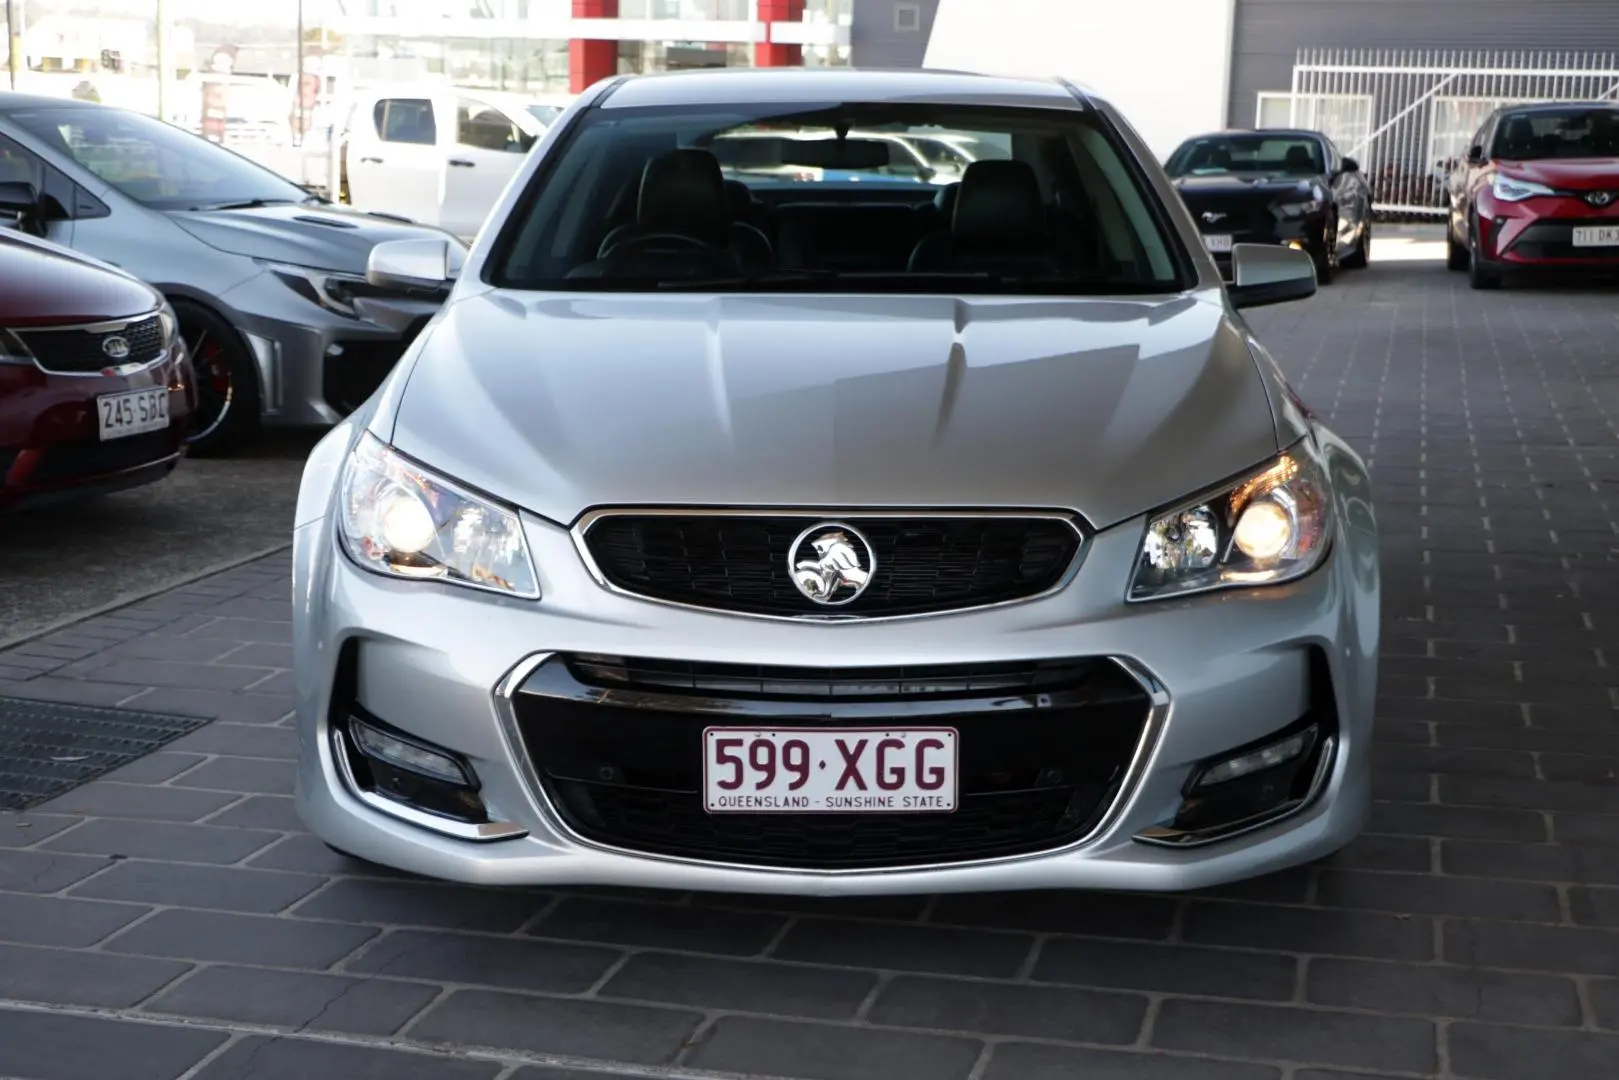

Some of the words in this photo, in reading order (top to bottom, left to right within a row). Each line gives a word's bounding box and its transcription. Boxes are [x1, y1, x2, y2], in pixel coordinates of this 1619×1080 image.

[715, 738, 810, 791] 599
[834, 738, 946, 791] XGG
[718, 795, 809, 808] QUEENSLAND
[825, 795, 894, 808] SUNSHINE
[902, 795, 943, 808] STATE
